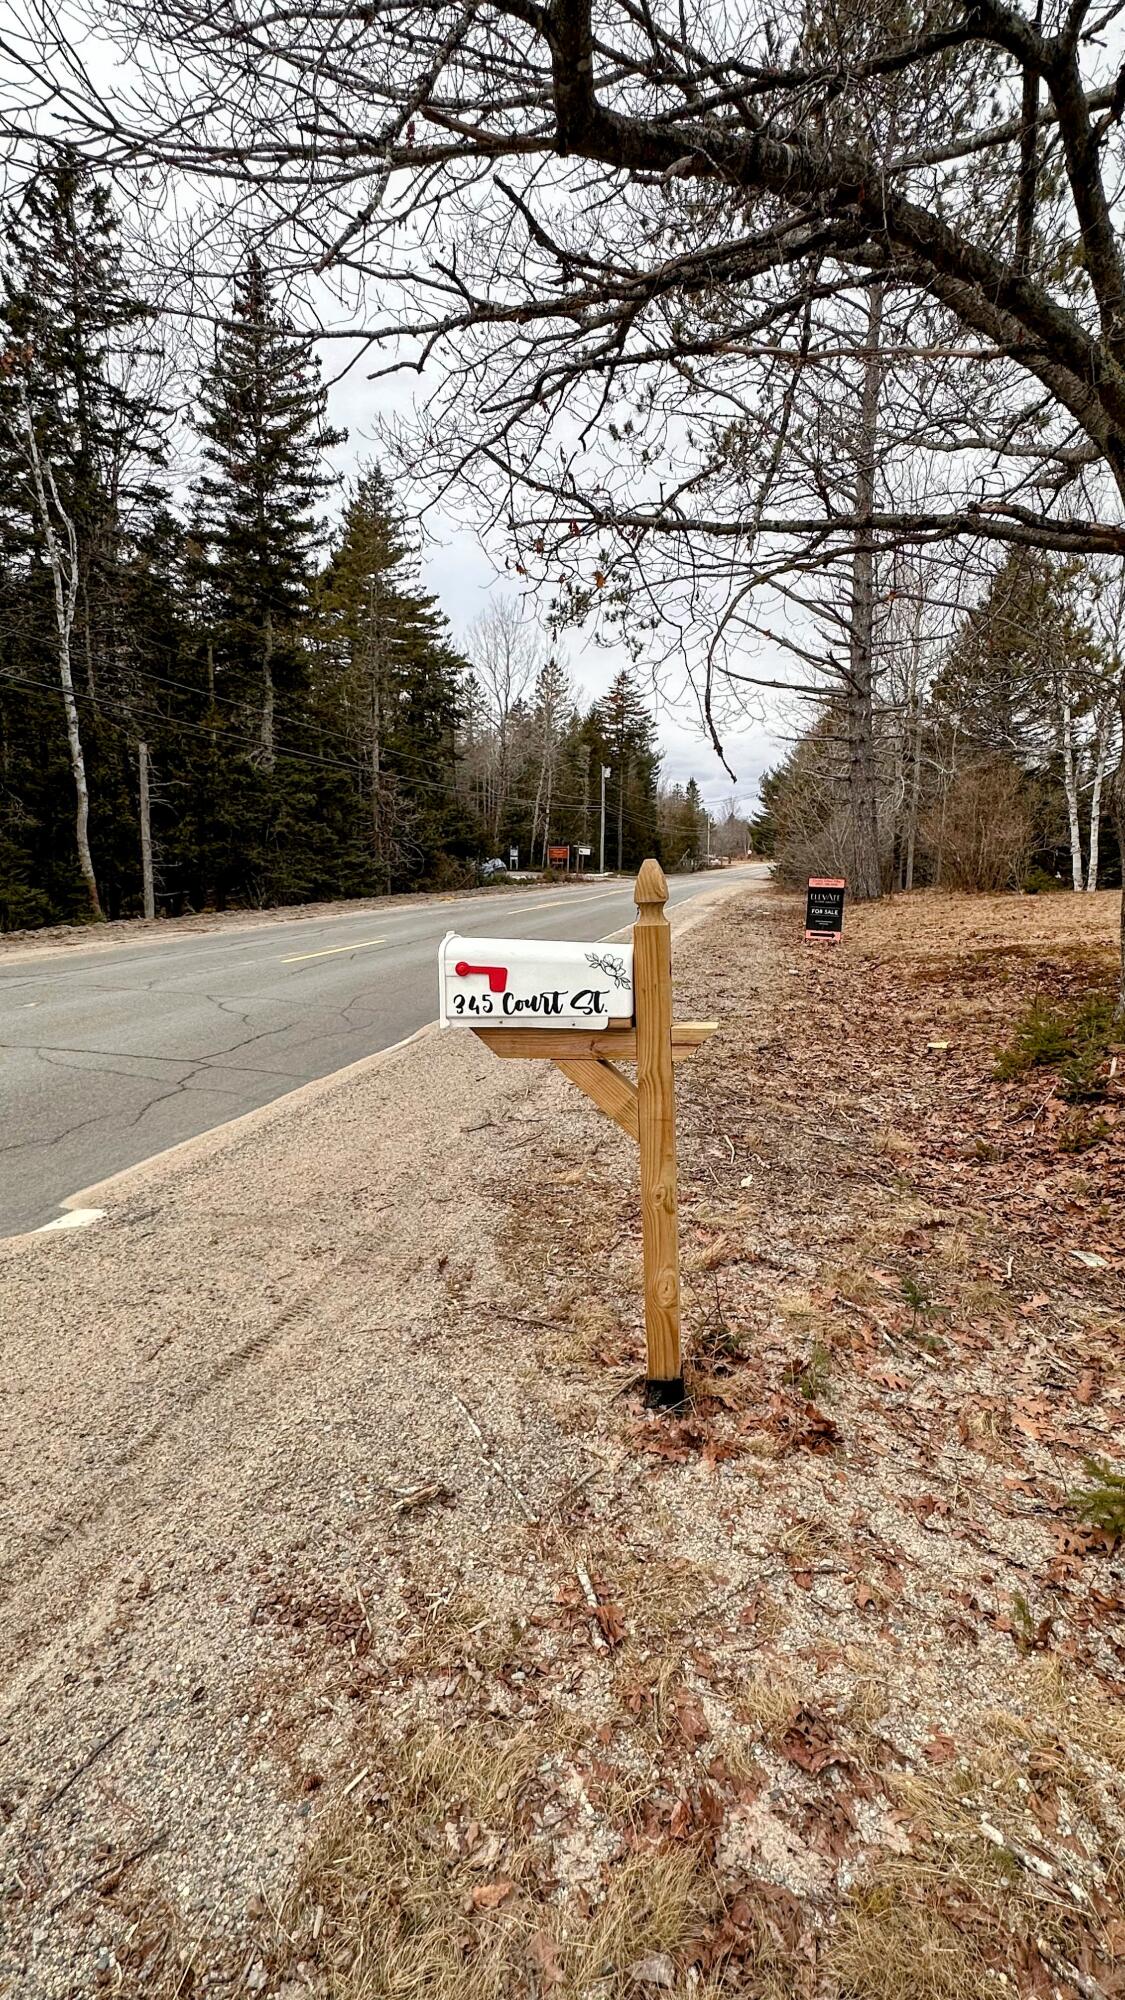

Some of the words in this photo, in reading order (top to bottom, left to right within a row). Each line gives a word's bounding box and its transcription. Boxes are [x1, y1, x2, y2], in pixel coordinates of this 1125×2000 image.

[810, 893, 841, 901] ELEVATE
[453, 994, 493, 1014] 345
[502, 990, 569, 1015] Court
[570, 989, 610, 1015] St.
